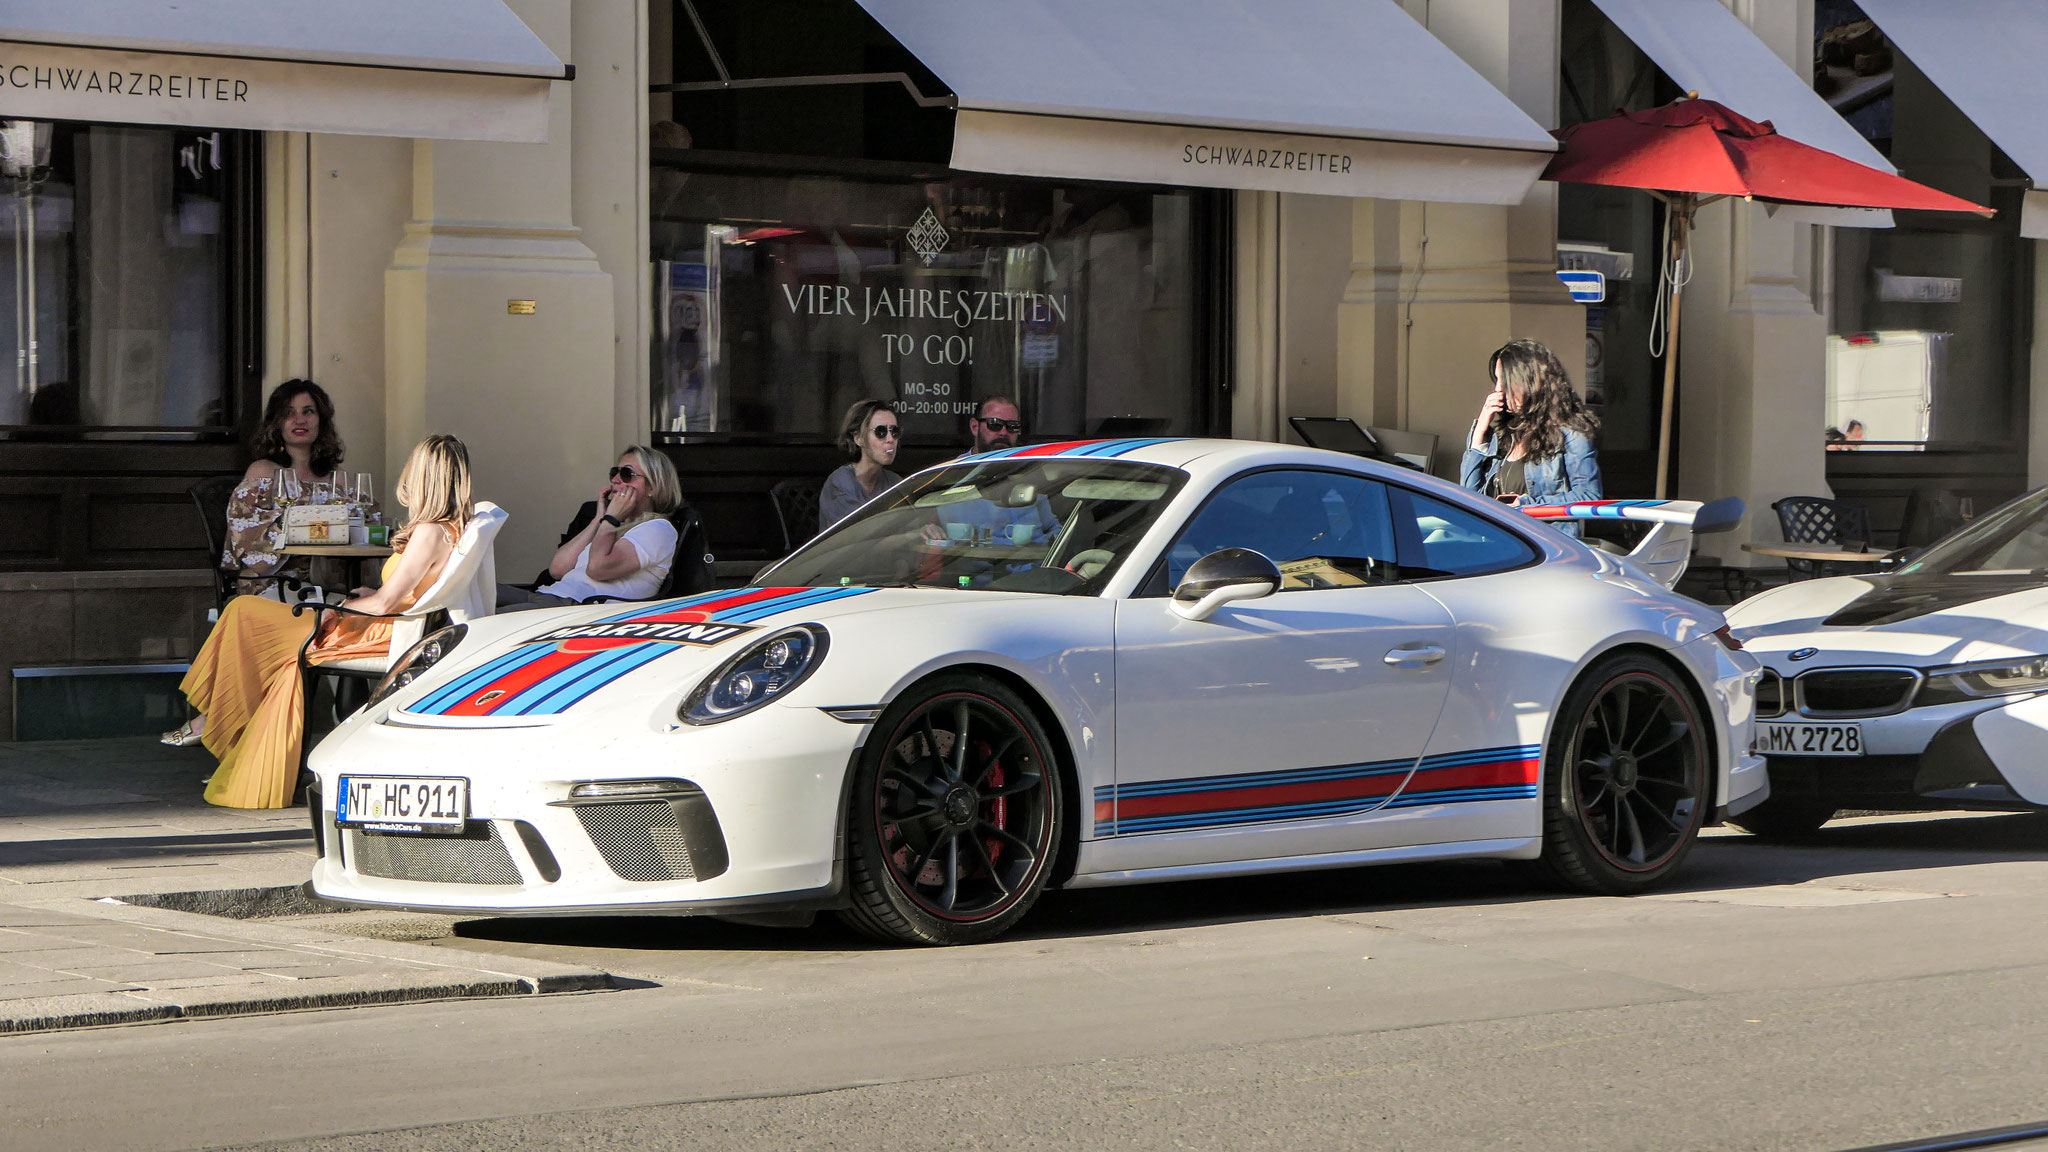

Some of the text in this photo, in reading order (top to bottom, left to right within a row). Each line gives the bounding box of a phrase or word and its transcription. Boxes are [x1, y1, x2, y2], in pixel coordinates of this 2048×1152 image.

[0, 65, 248, 102] CHWARZREITER
[1183, 144, 1352, 174] SCHWARZREITER
[782, 283, 1067, 328] VIER JAHRESZEITEN
[922, 334, 974, 365] GO!
[534, 624, 740, 642] MARTINI
[1769, 725, 1797, 752] MX
[1802, 726, 1859, 752] 2728
[348, 782, 459, 818] NT HC 911
